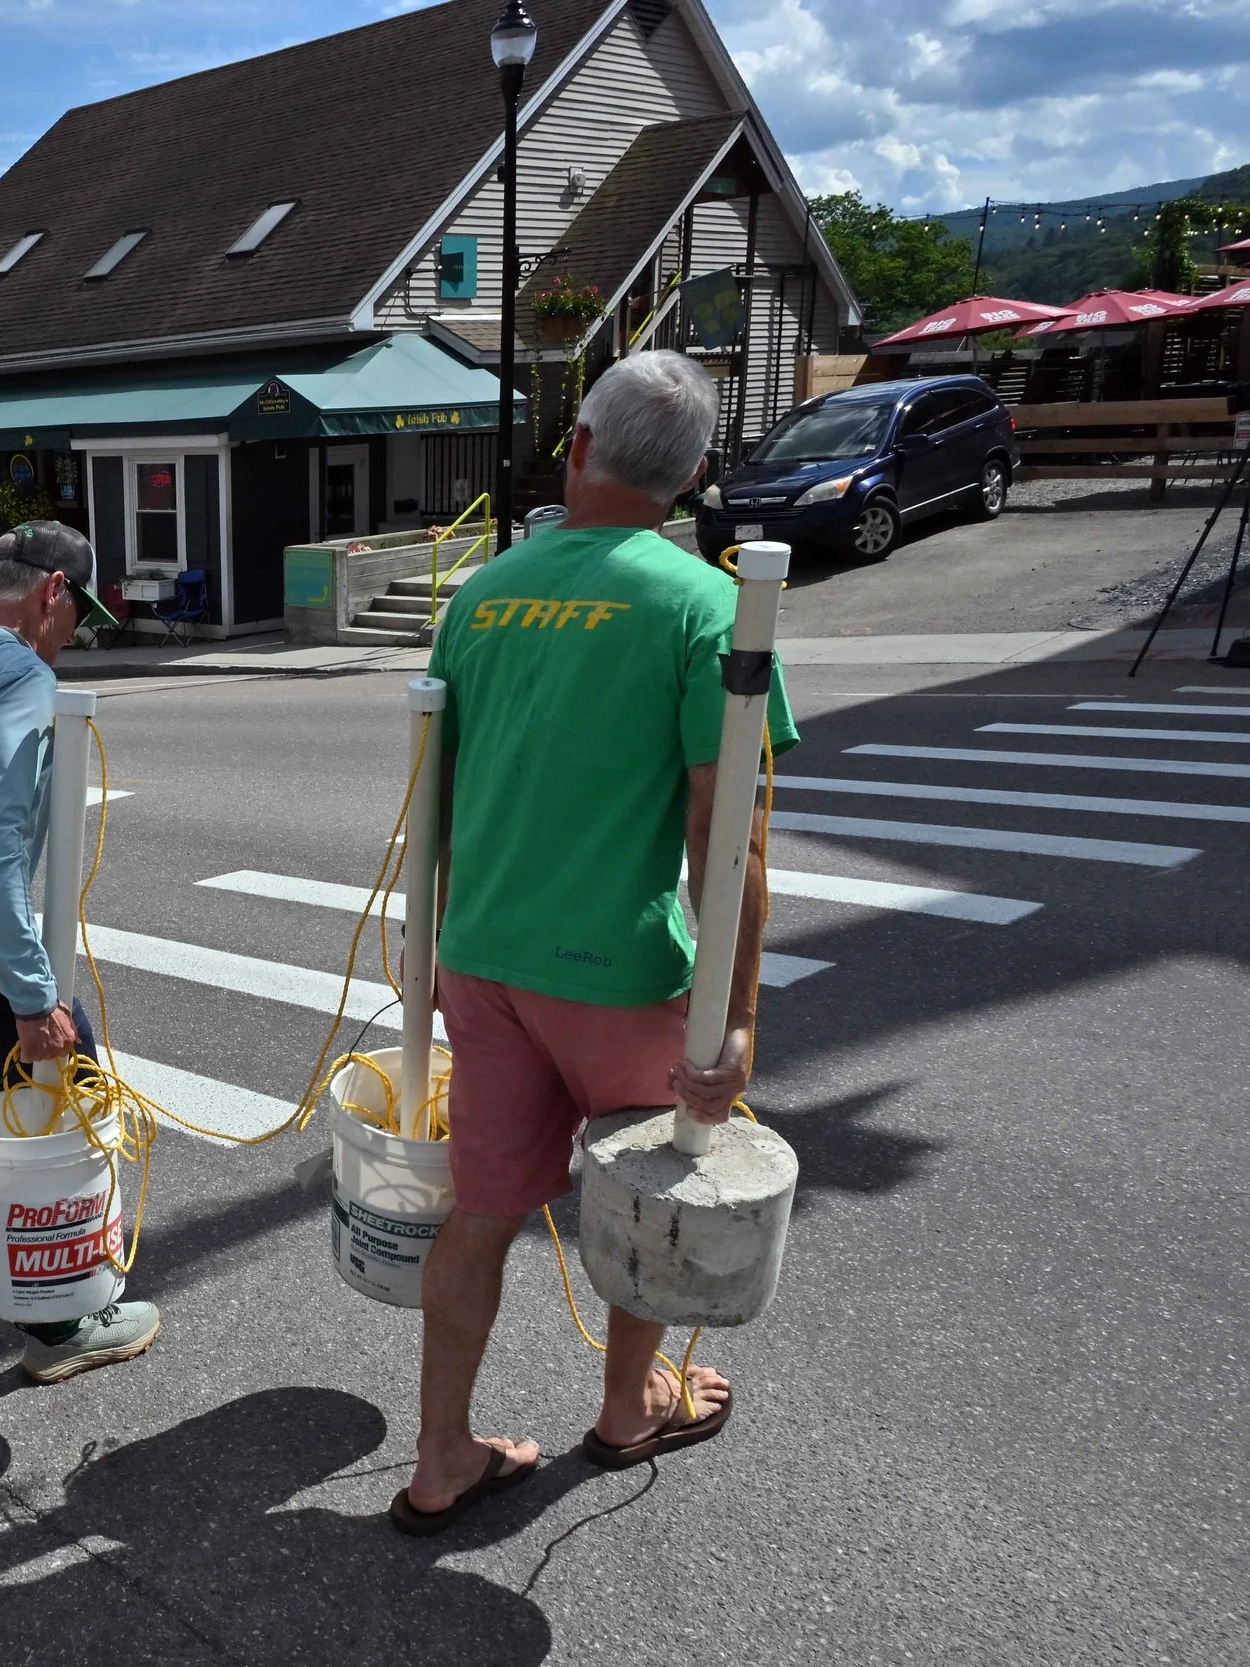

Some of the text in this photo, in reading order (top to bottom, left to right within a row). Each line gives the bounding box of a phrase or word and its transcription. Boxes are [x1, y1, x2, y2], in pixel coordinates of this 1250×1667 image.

[407, 411, 448, 424] Irish Pub
[470, 597, 633, 631] STAFF
[553, 945, 612, 968] LeeRob
[350, 1205, 440, 1238] SHEETROCK
[6, 1228, 87, 1244] Professional Formula
[351, 1224, 399, 1251] All Purpose
[351, 1235, 369, 1252] Joint
[370, 1246, 420, 1264] Compound
[350, 1253, 365, 1274] USG
